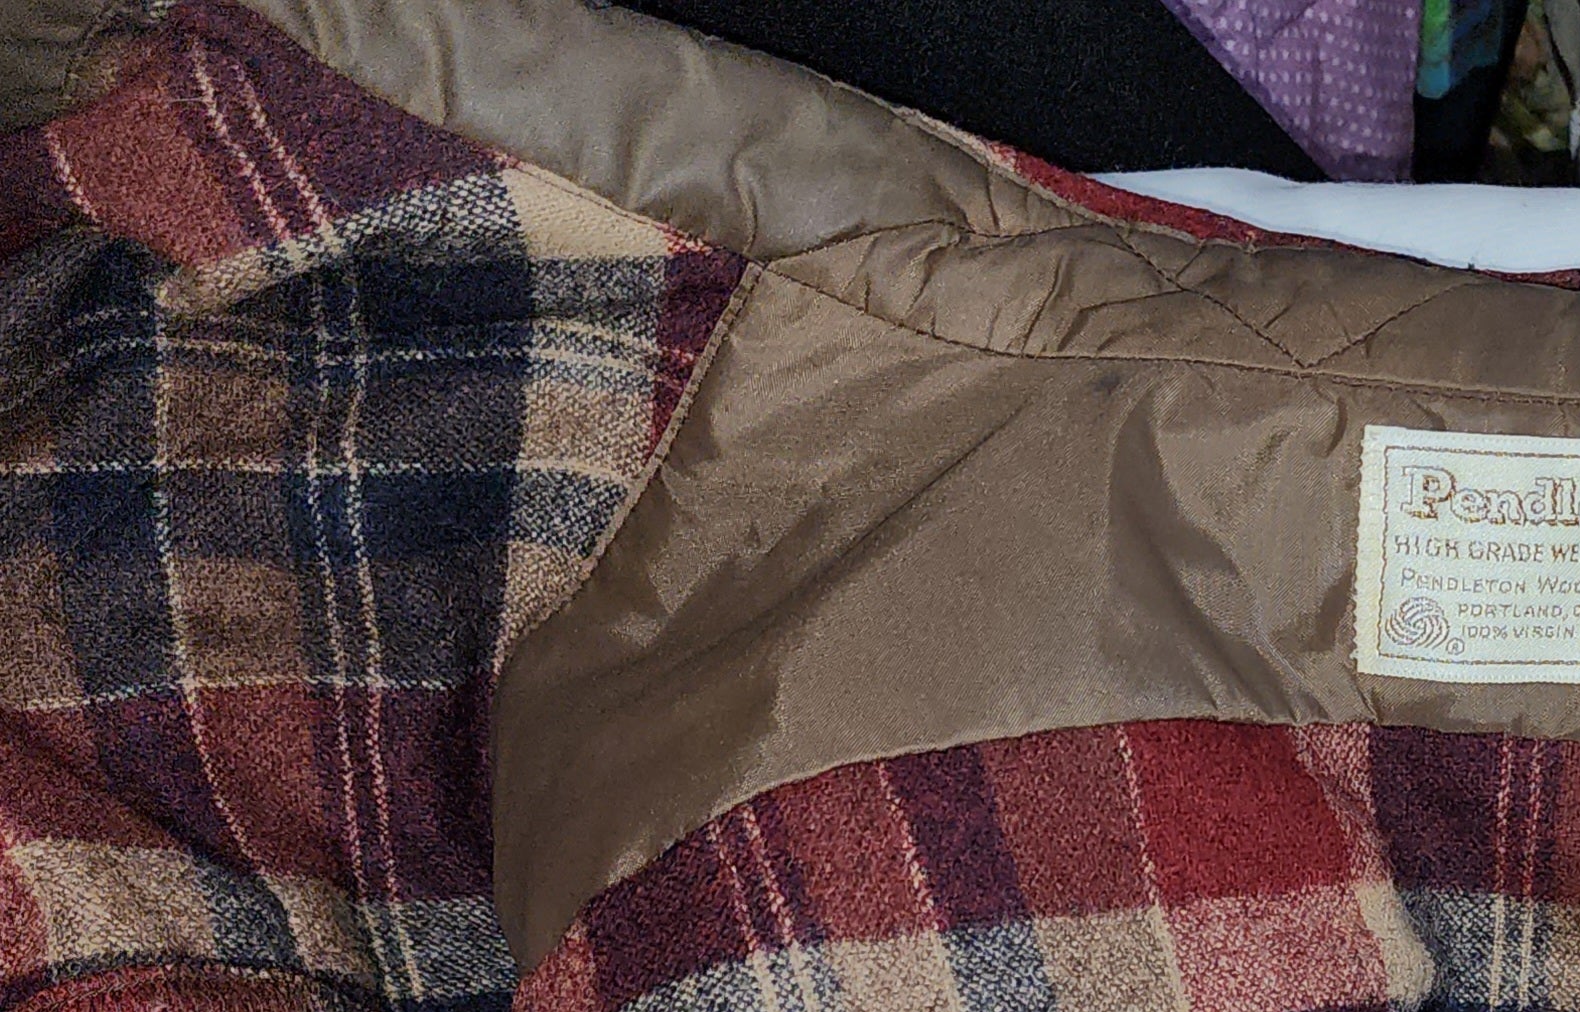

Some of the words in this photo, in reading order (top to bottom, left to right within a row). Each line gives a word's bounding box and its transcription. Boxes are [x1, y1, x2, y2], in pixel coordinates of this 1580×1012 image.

[1395, 535, 1460, 560] HIGH
[1468, 539, 1544, 563] GRADE
[1457, 603, 1568, 622] PORTLAND,
[1461, 625, 1508, 641] 100%
[1512, 626, 1576, 641] VIRGIN
